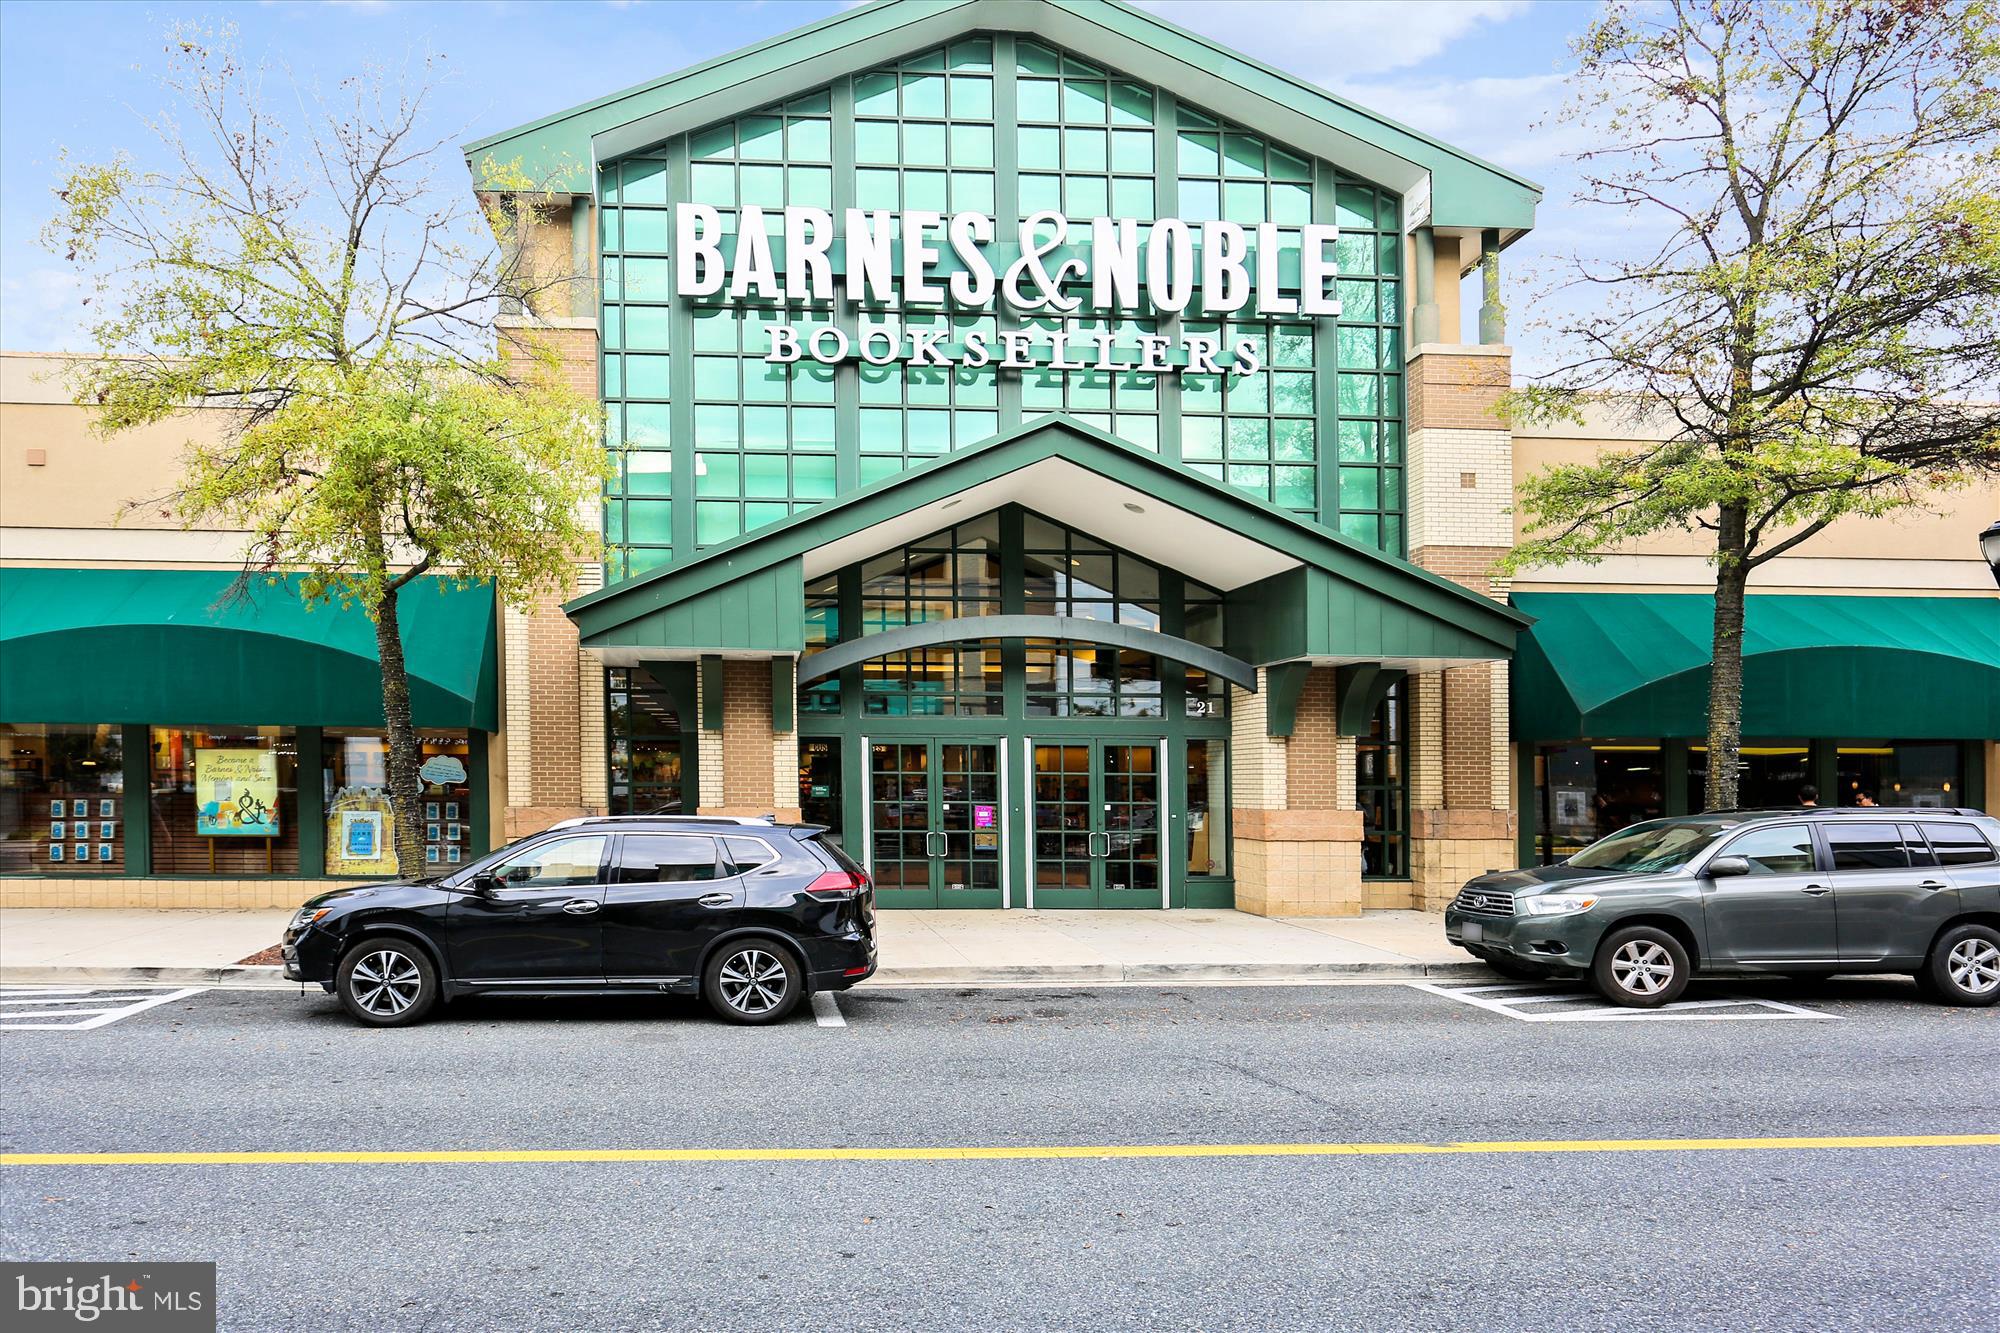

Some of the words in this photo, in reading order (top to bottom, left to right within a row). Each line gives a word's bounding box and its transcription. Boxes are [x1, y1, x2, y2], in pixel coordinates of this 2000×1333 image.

[764, 325, 1261, 376] BOOKSELLERS
[1197, 701, 1215, 714] 21
[217, 755, 247, 764] Become
[205, 764, 232, 773] Barnes
[201, 774, 232, 782] Member
[235, 774, 251, 782] and
[253, 774, 271, 783] Save
